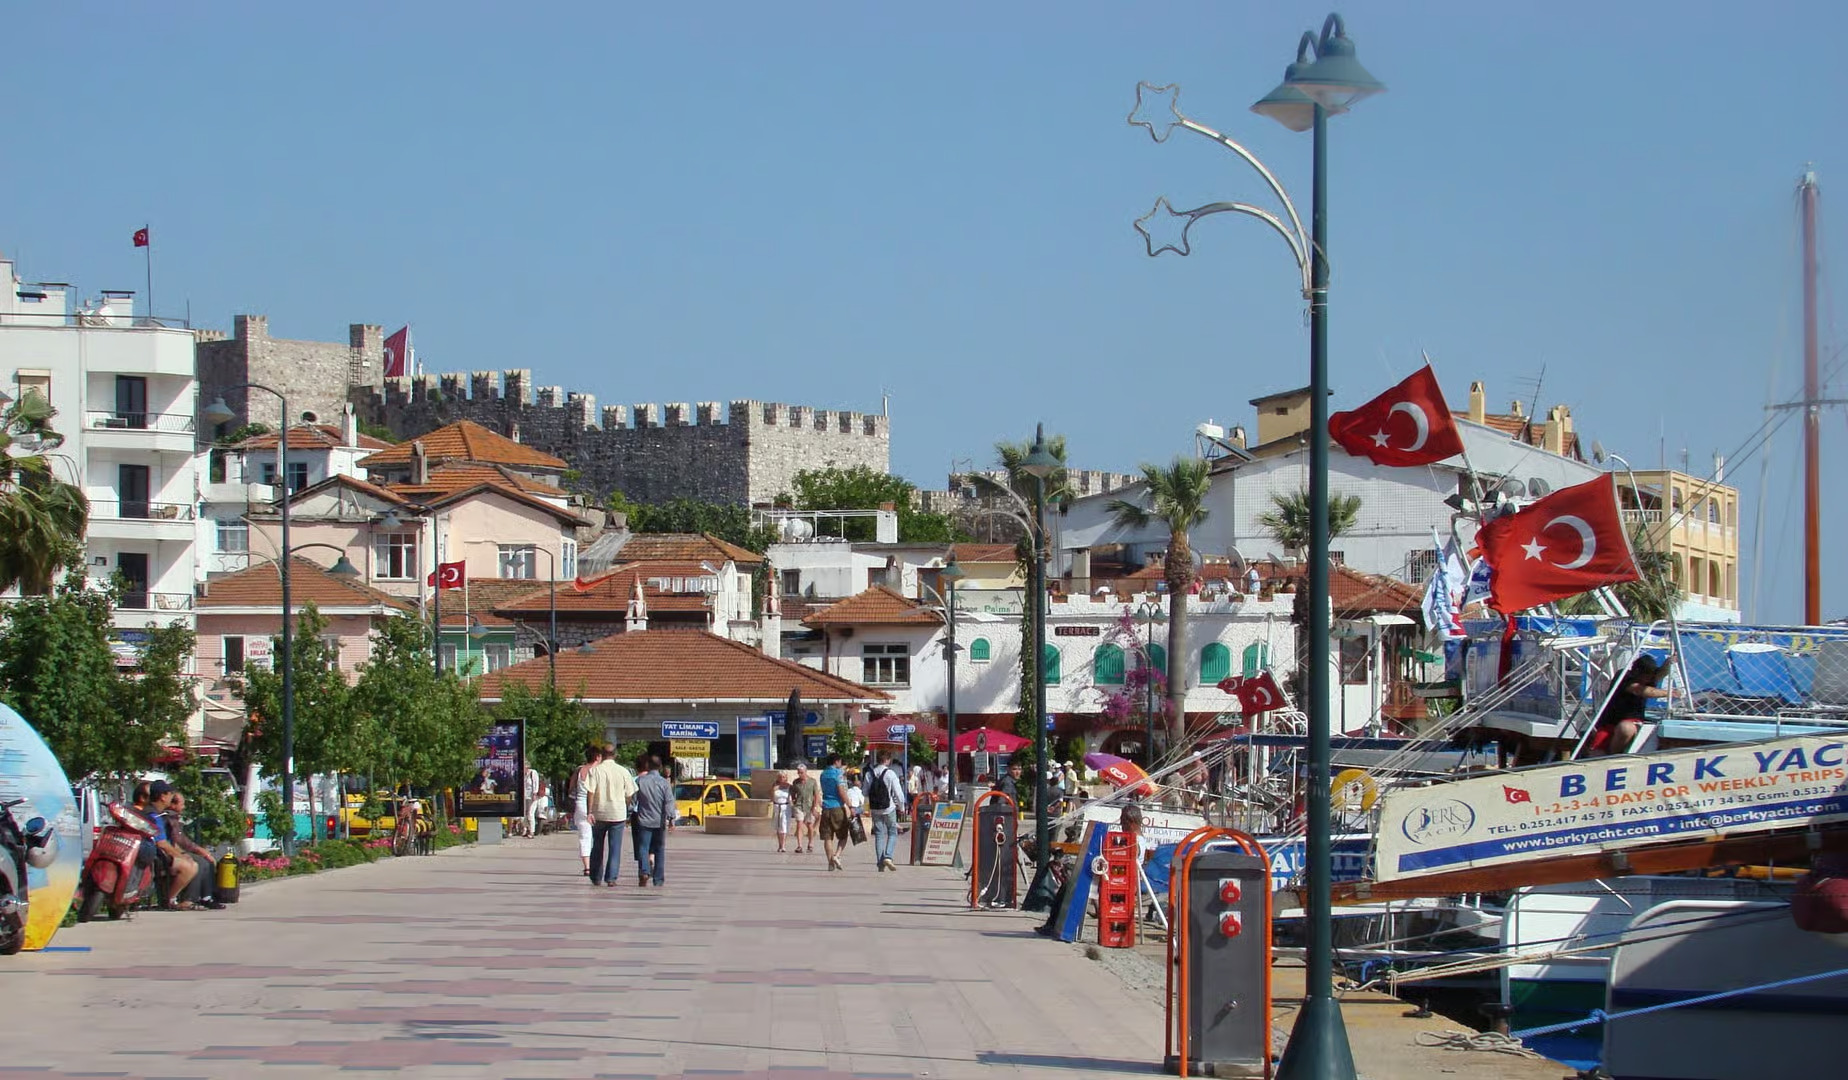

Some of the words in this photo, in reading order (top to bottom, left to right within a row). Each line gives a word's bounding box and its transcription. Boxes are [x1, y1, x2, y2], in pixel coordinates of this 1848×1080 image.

[1535, 797, 1600, 815] 1-2-3-4
[1606, 790, 1655, 806] DAYS
[1662, 785, 1690, 798] OR
[1698, 774, 1779, 793] WEEKLY
[1786, 768, 1845, 784] TRIPS
[1560, 755, 1728, 797] BERK
[1753, 744, 1848, 773] YAC
[1416, 807, 1470, 831] BERK
[1488, 824, 1517, 835] TEL:
[1519, 815, 1576, 830] 0.252.417
[1581, 813, 1595, 821] 45
[1600, 811, 1614, 819] 75
[1622, 806, 1653, 816] FAX:
[1656, 798, 1715, 812] 0.252.417
[1719, 796, 1735, 805] 34
[1738, 794, 1753, 802] 52
[1756, 791, 1789, 801] Gsm:
[1503, 824, 1659, 851] www.berkyacht.com
[1679, 803, 1841, 829] info@berkyacht.com
